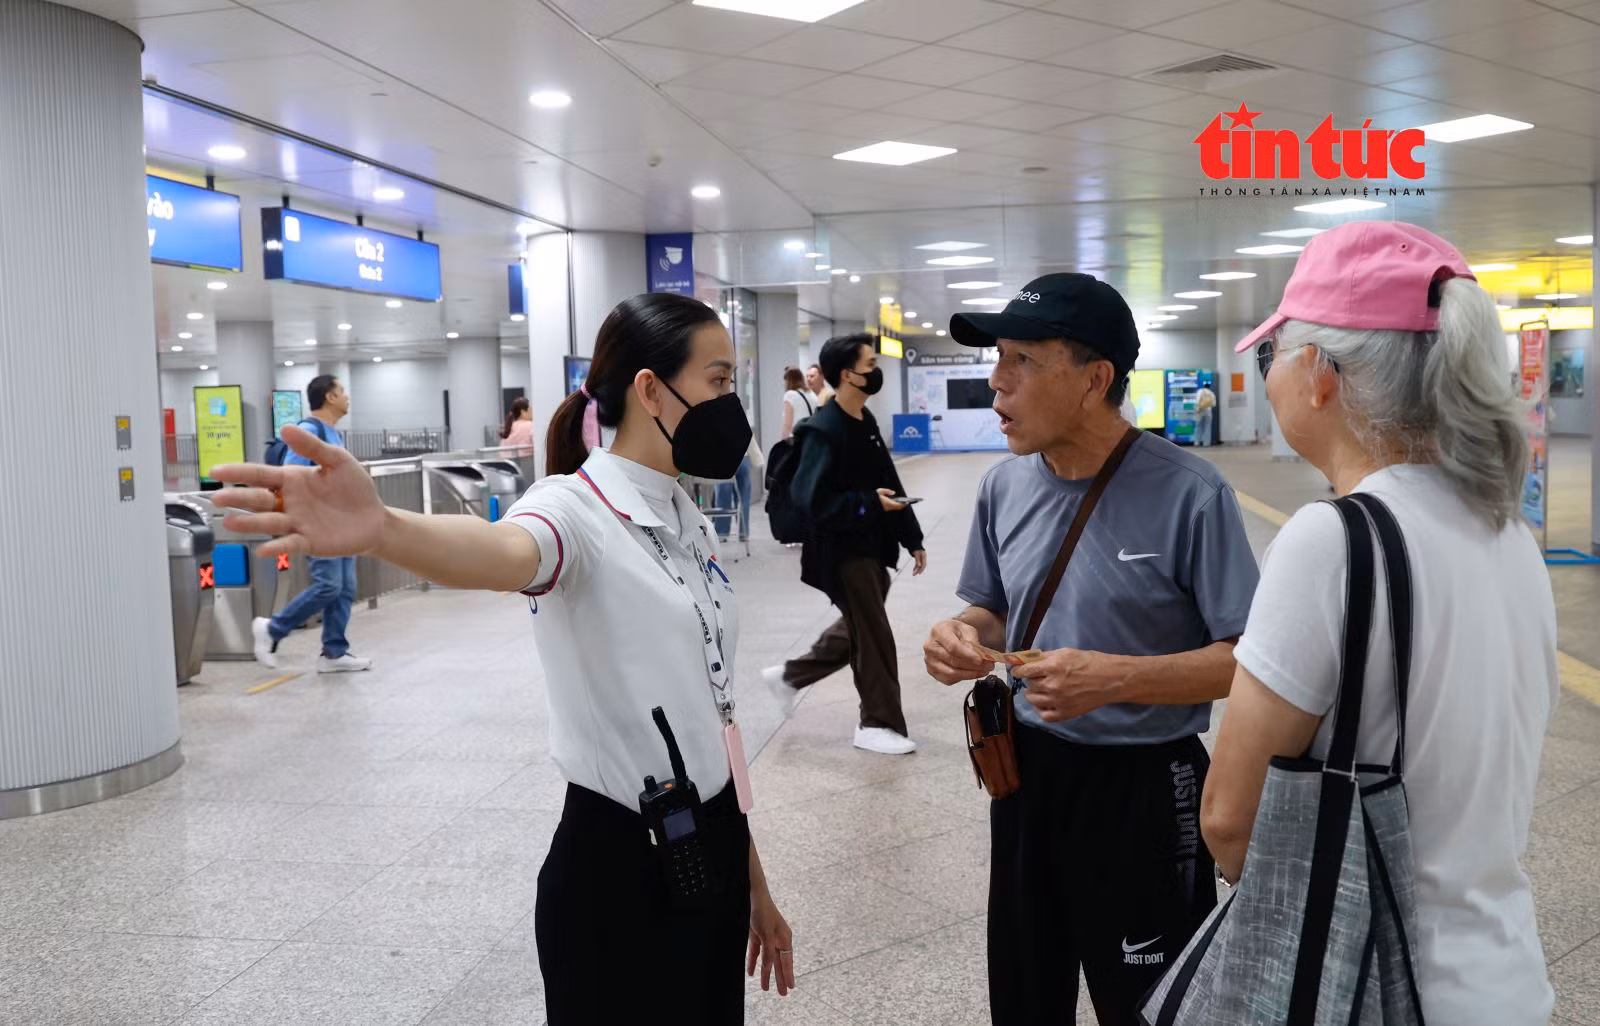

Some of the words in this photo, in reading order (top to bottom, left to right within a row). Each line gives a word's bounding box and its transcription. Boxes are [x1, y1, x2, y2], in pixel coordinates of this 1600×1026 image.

[376, 241, 384, 262] 2
[1169, 760, 1197, 808] JUST
[1123, 953, 1143, 965] JUST
